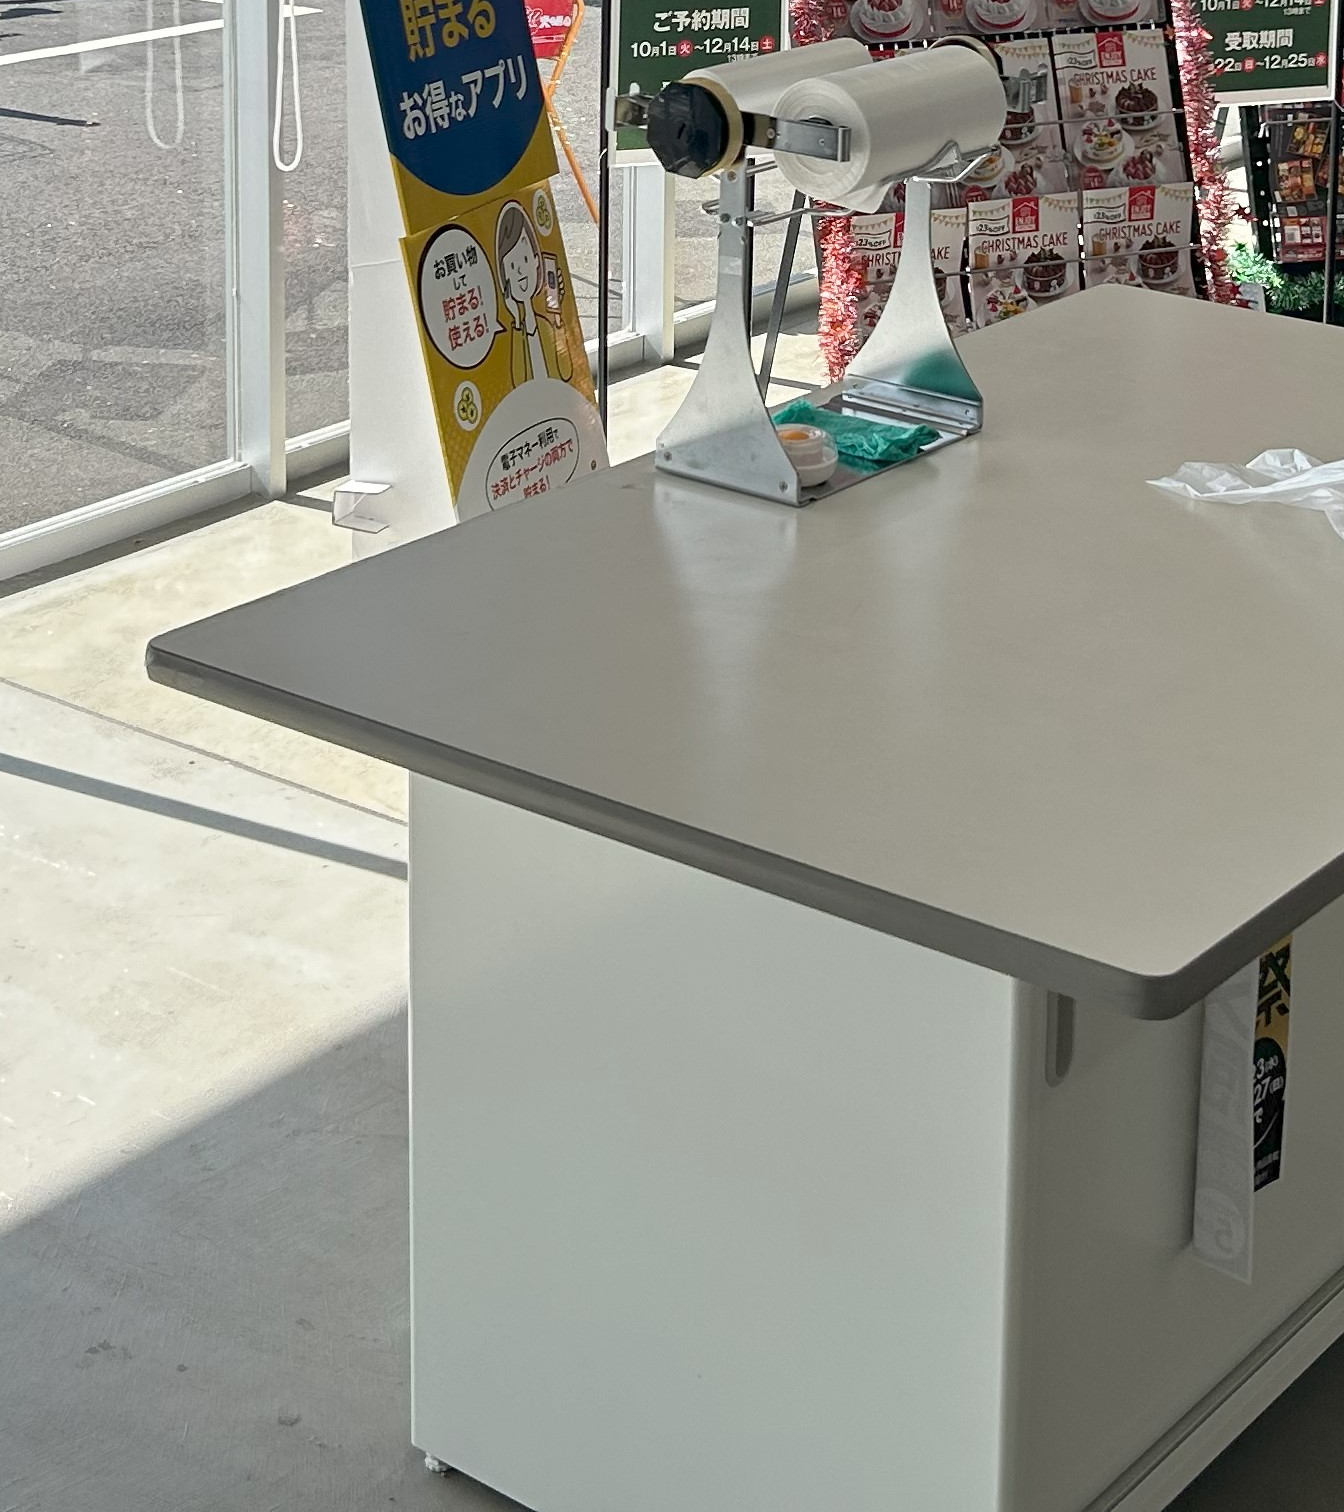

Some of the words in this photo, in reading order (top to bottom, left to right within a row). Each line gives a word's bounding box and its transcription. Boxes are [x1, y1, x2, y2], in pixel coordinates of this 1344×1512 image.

[653, 7, 750, 32] ご予約期間
[1225, 28, 1294, 52] 受取期間
[1074, 70, 1127, 86] CHRISTMAS
[1130, 67, 1157, 82] CAKE
[400, 54, 527, 140] お得なアプリ
[981, 236, 1039, 253] CHRISTMAS
[1042, 232, 1068, 248] CAKE
[1100, 224, 1154, 241] CHRISTMAS
[1157, 220, 1182, 235] CAKE
[433, 245, 479, 281] お買い物
[861, 250, 902, 268] CHRIST
[453, 274, 467, 291] して
[442, 285, 484, 323] 貯まる!
[448, 313, 489, 351] 使える!
